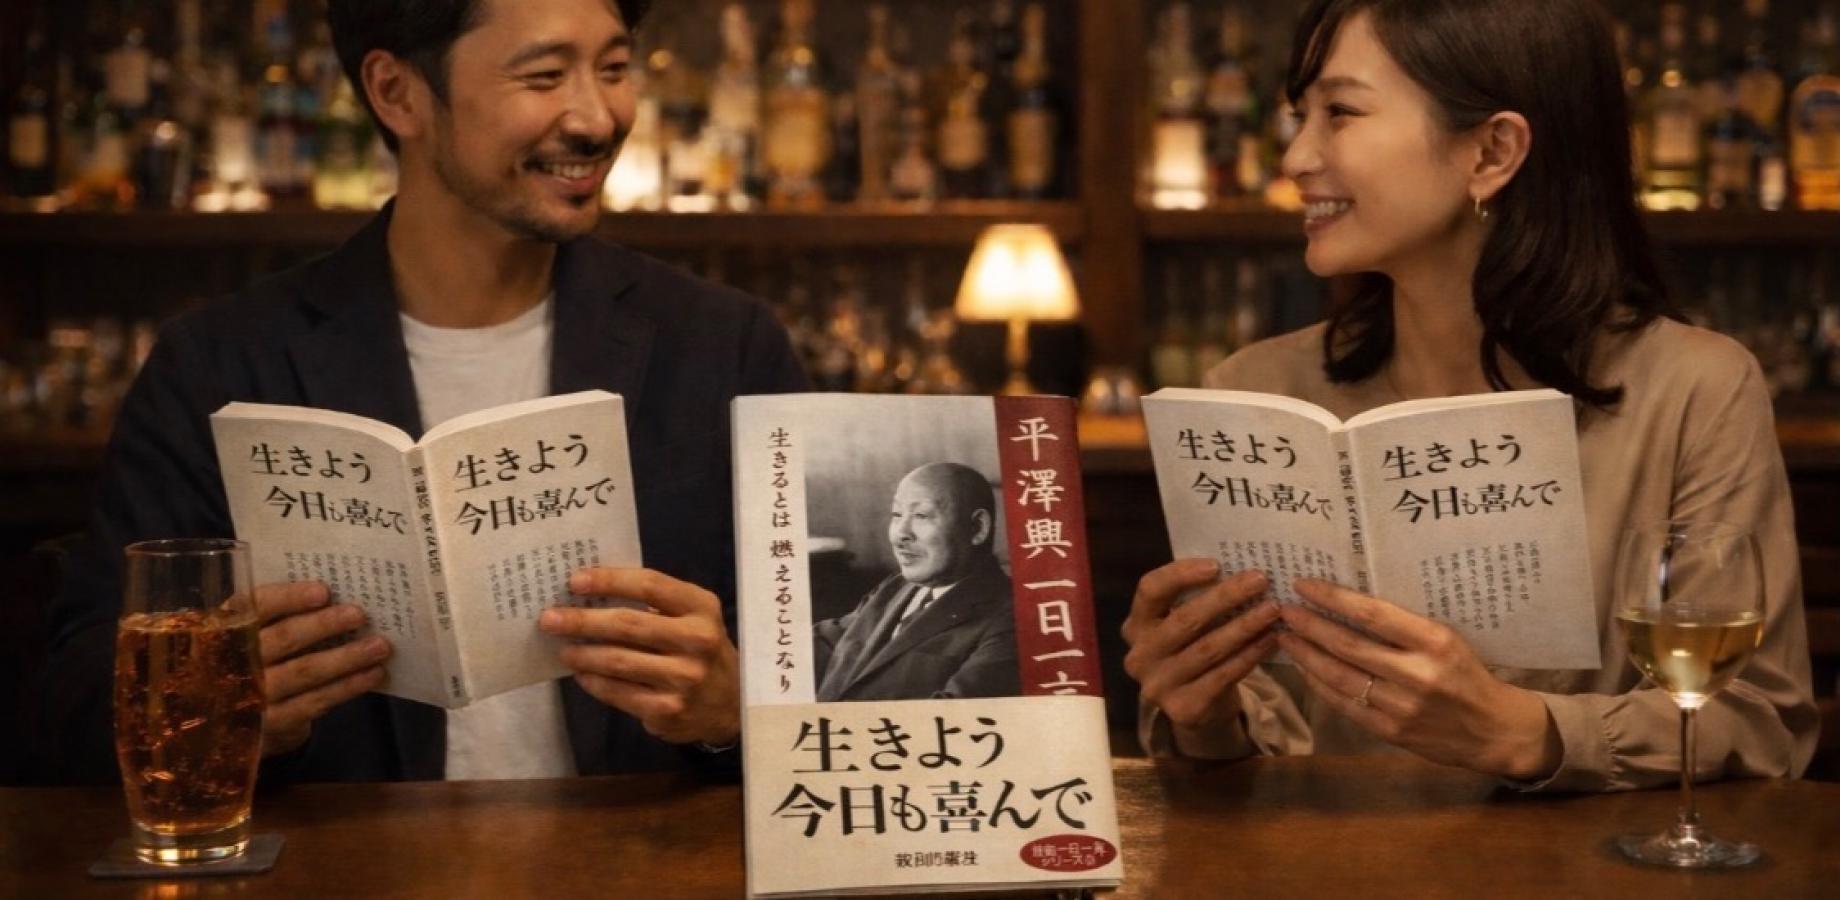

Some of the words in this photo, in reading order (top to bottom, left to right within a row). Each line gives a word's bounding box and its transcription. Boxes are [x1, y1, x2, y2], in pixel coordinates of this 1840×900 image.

[249, 442, 372, 484] 生きよう
[452, 434, 590, 493] 生きよう
[1177, 427, 1297, 469] 生きよう
[1382, 433, 1523, 482] 生きよう
[767, 427, 792, 528] 生きるとは
[1190, 472, 1335, 522] 今日も喜んで
[1390, 480, 1563, 523] 今日も喜んで
[265, 485, 407, 535] 今日も喜んで
[452, 477, 617, 536] 今日も喜んで
[769, 539, 795, 693] 燃えることなり
[790, 716, 1005, 774] 生きよう
[771, 777, 1093, 838] 今日も喜んで
